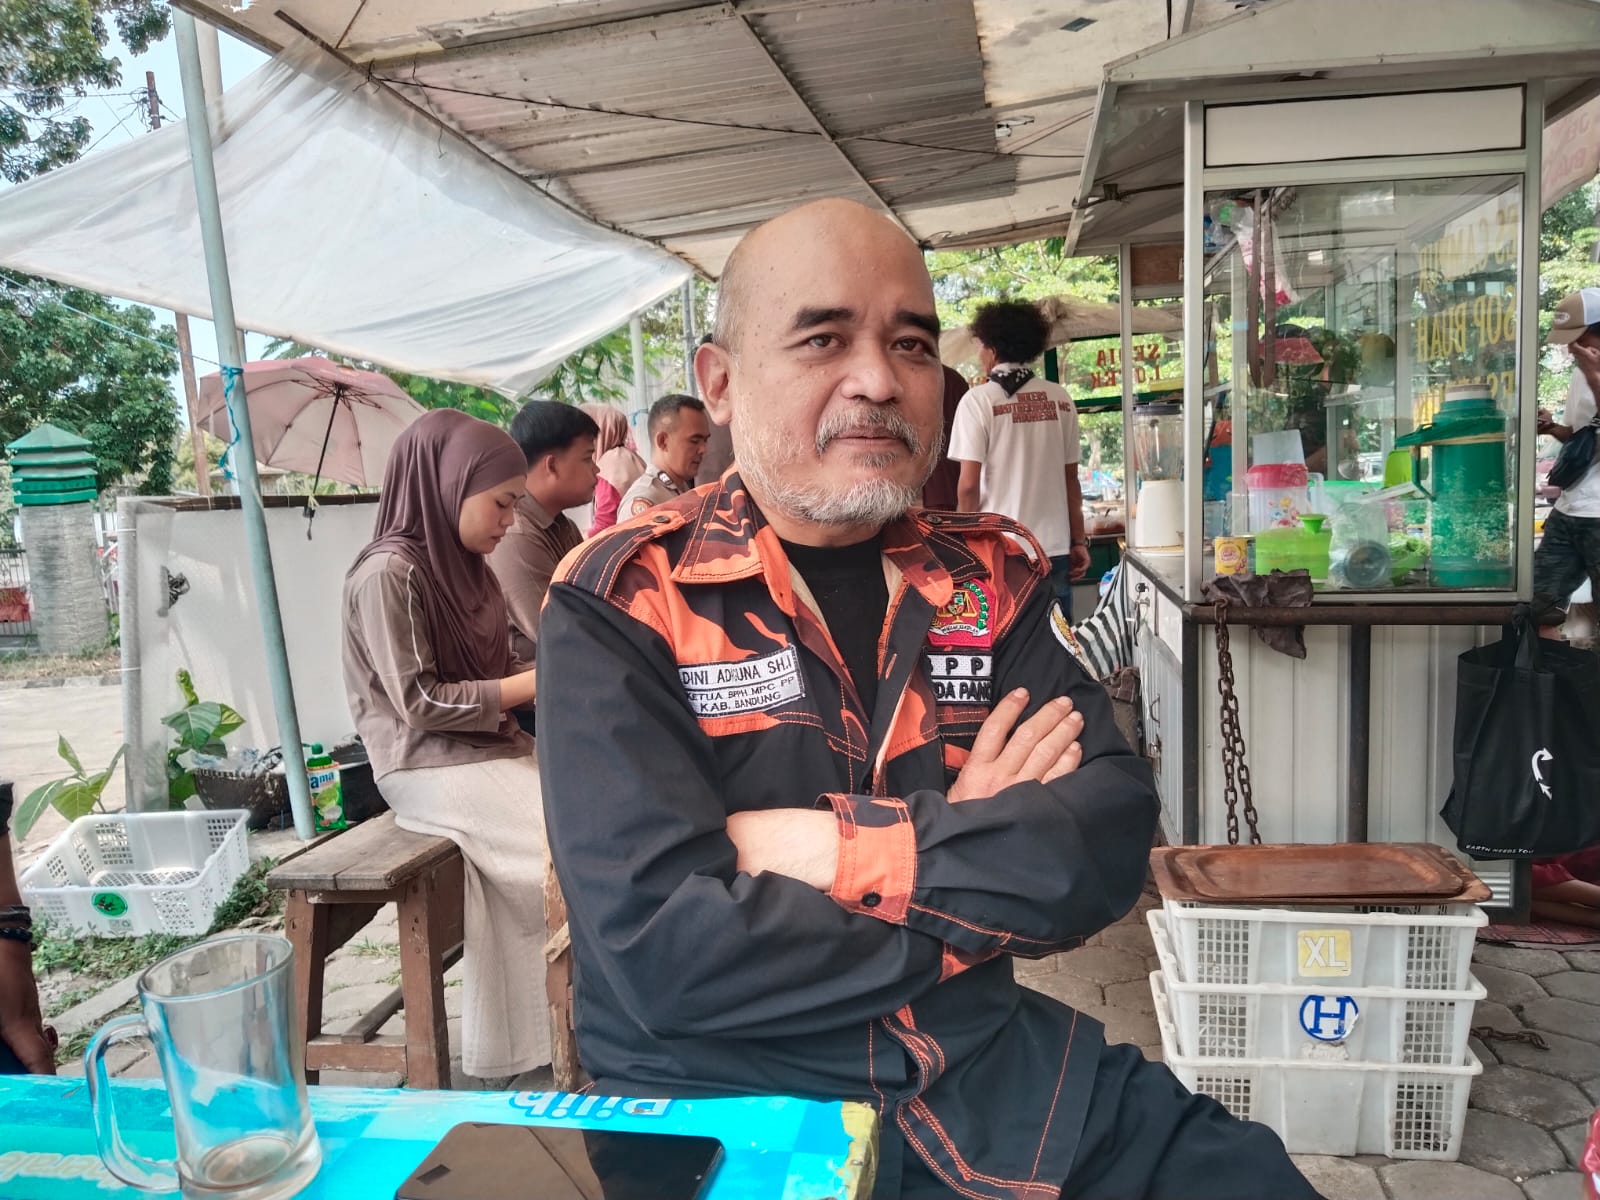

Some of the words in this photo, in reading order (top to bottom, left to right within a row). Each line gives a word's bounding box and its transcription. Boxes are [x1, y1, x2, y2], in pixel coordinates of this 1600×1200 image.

[682, 670, 709, 686] DINI
[686, 691, 724, 701] KETUA
[751, 683, 776, 695] MPC
[780, 676, 795, 688] PP
[700, 702, 731, 713] KAB.
[735, 691, 781, 709] BANDUNG
[1303, 935, 1348, 968] XL
